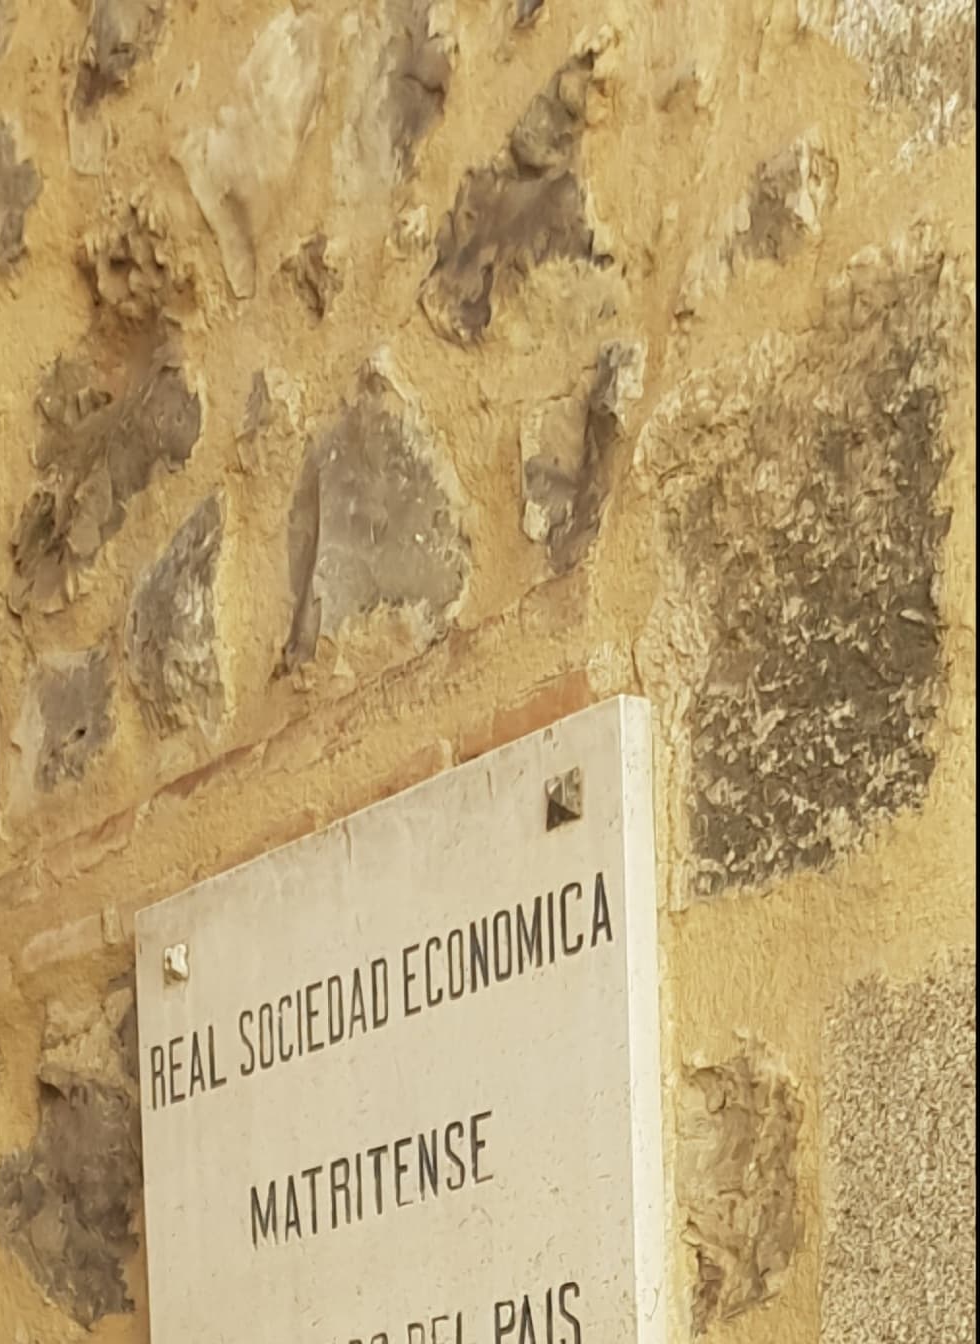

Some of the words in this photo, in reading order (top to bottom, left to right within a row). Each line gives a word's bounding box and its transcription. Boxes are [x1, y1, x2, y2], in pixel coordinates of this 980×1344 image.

[149, 1025, 228, 1111] REAL
[238, 957, 390, 1077] SOCIEDAD
[402, 871, 613, 1017] ECONOMICA
[250, 1110, 494, 1250] MATRITENSE
